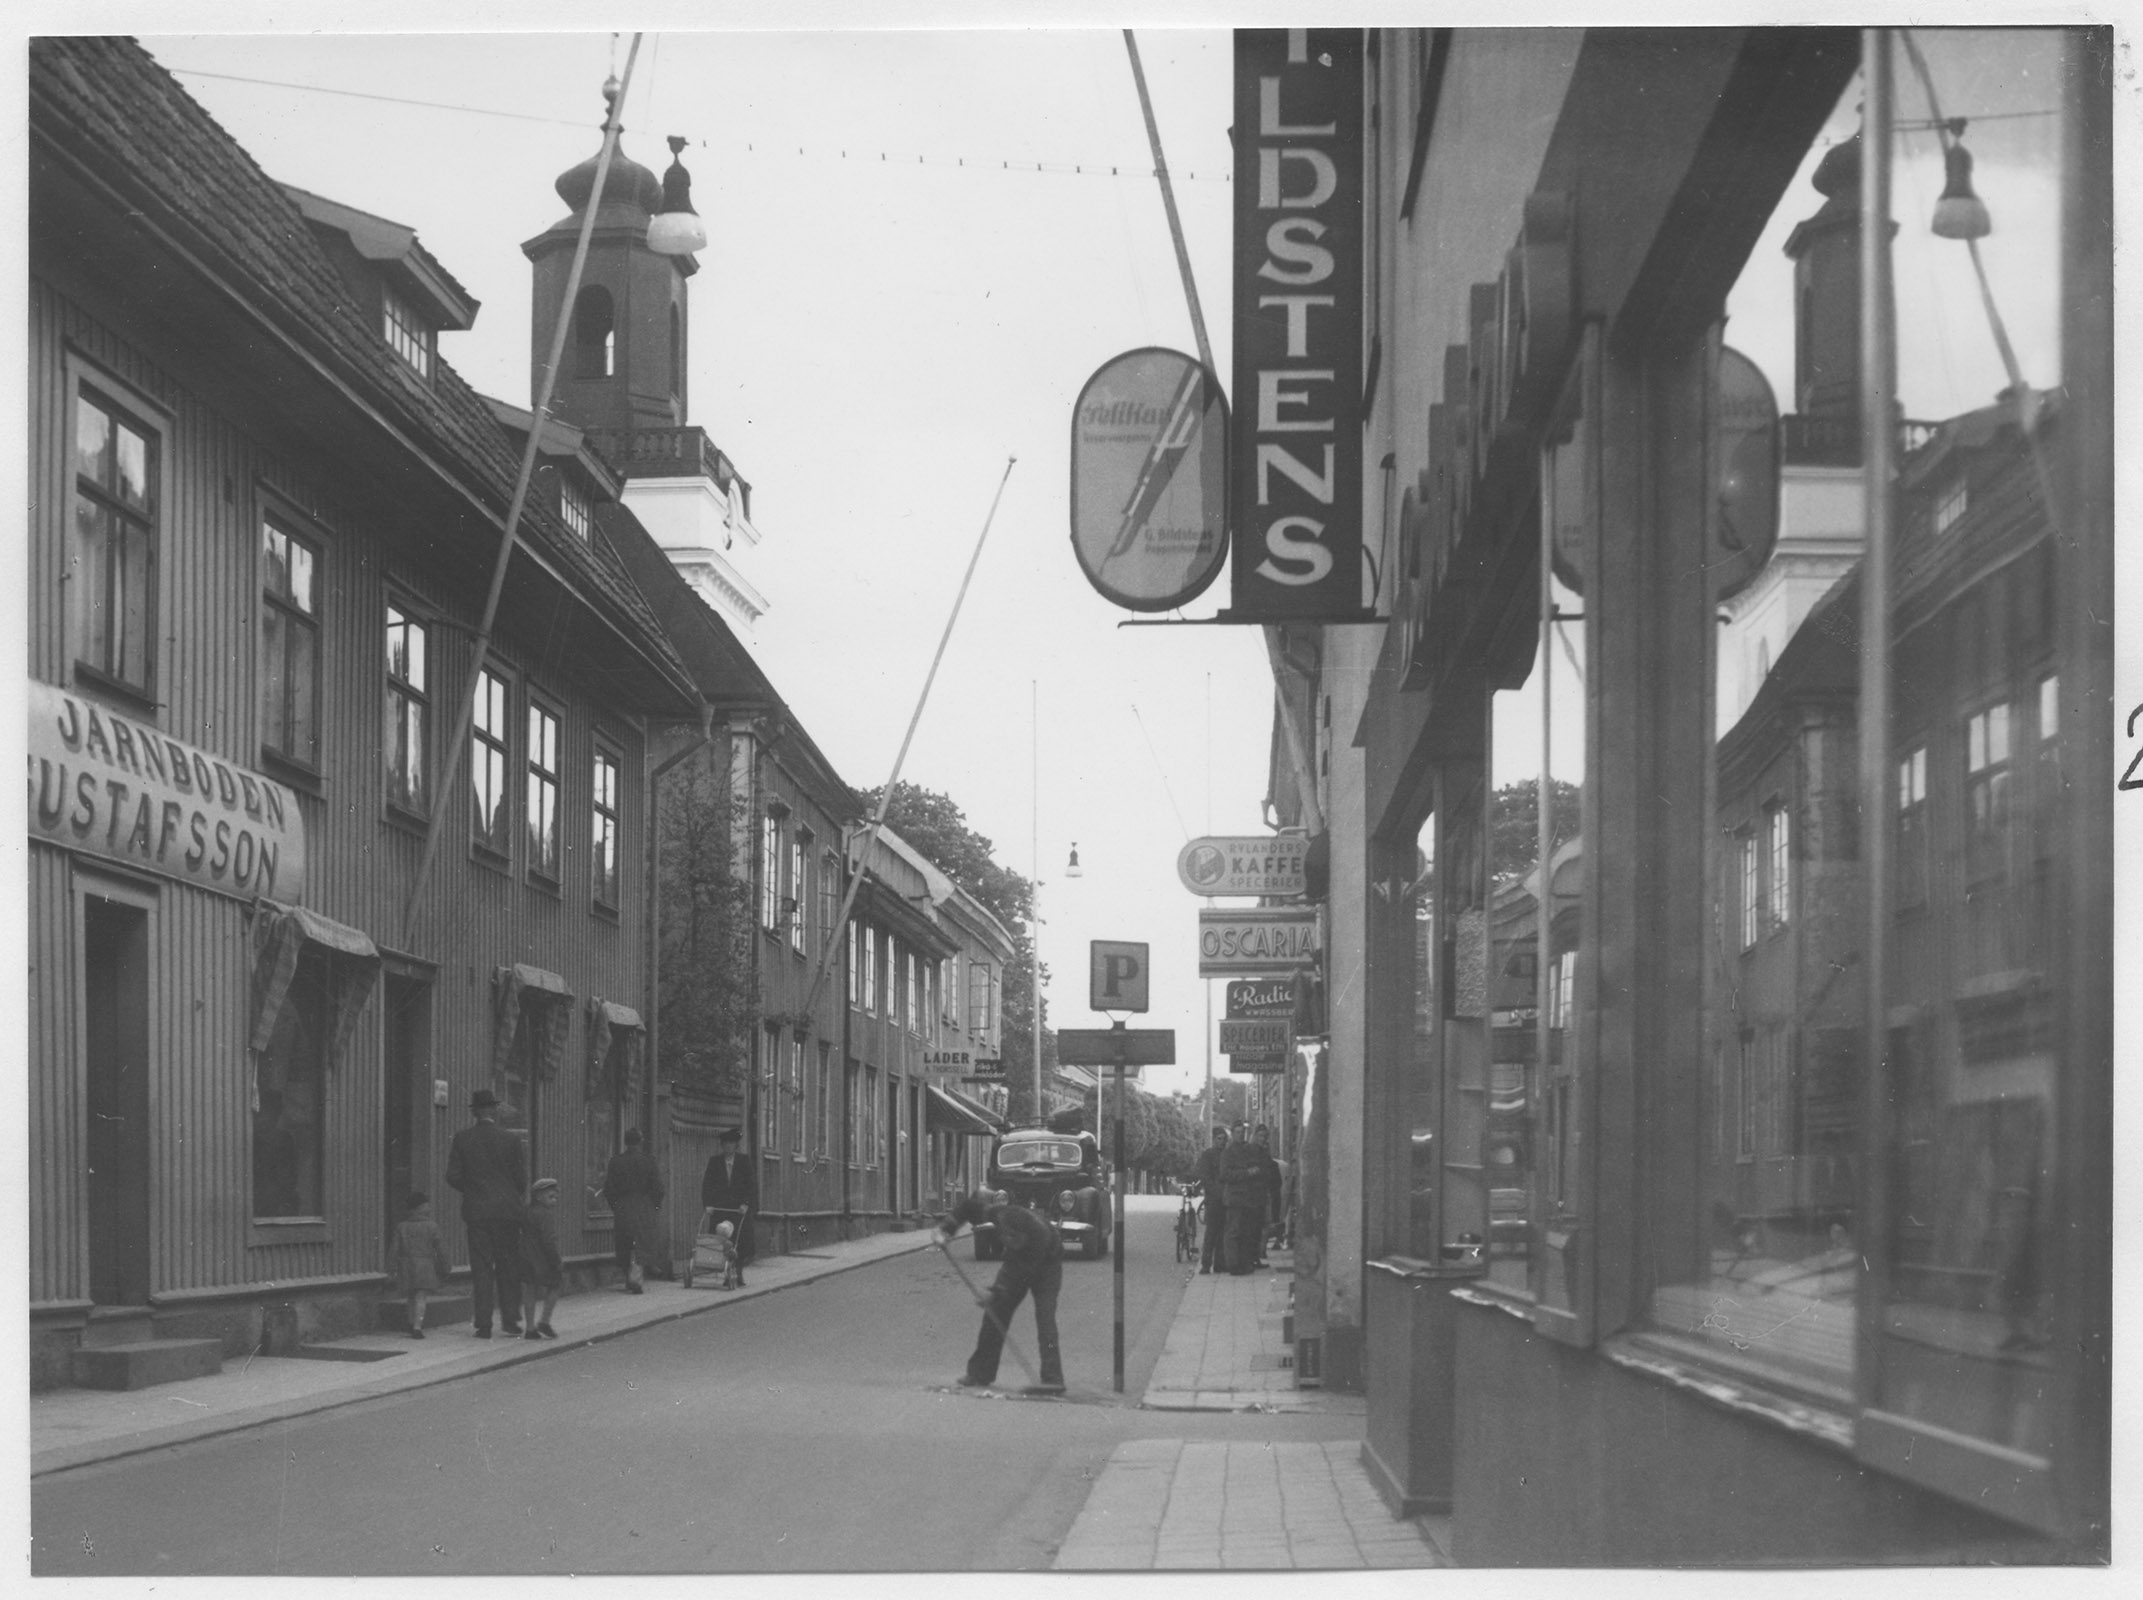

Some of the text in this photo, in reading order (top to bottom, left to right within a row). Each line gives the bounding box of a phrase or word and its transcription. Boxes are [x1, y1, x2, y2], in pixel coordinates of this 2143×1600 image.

[28, 755, 278, 897] USTAFSSON
[1231, 856, 1301, 874] KAFFE
[1202, 927, 1315, 958] OSCARIA
[1103, 954, 1139, 997] P
